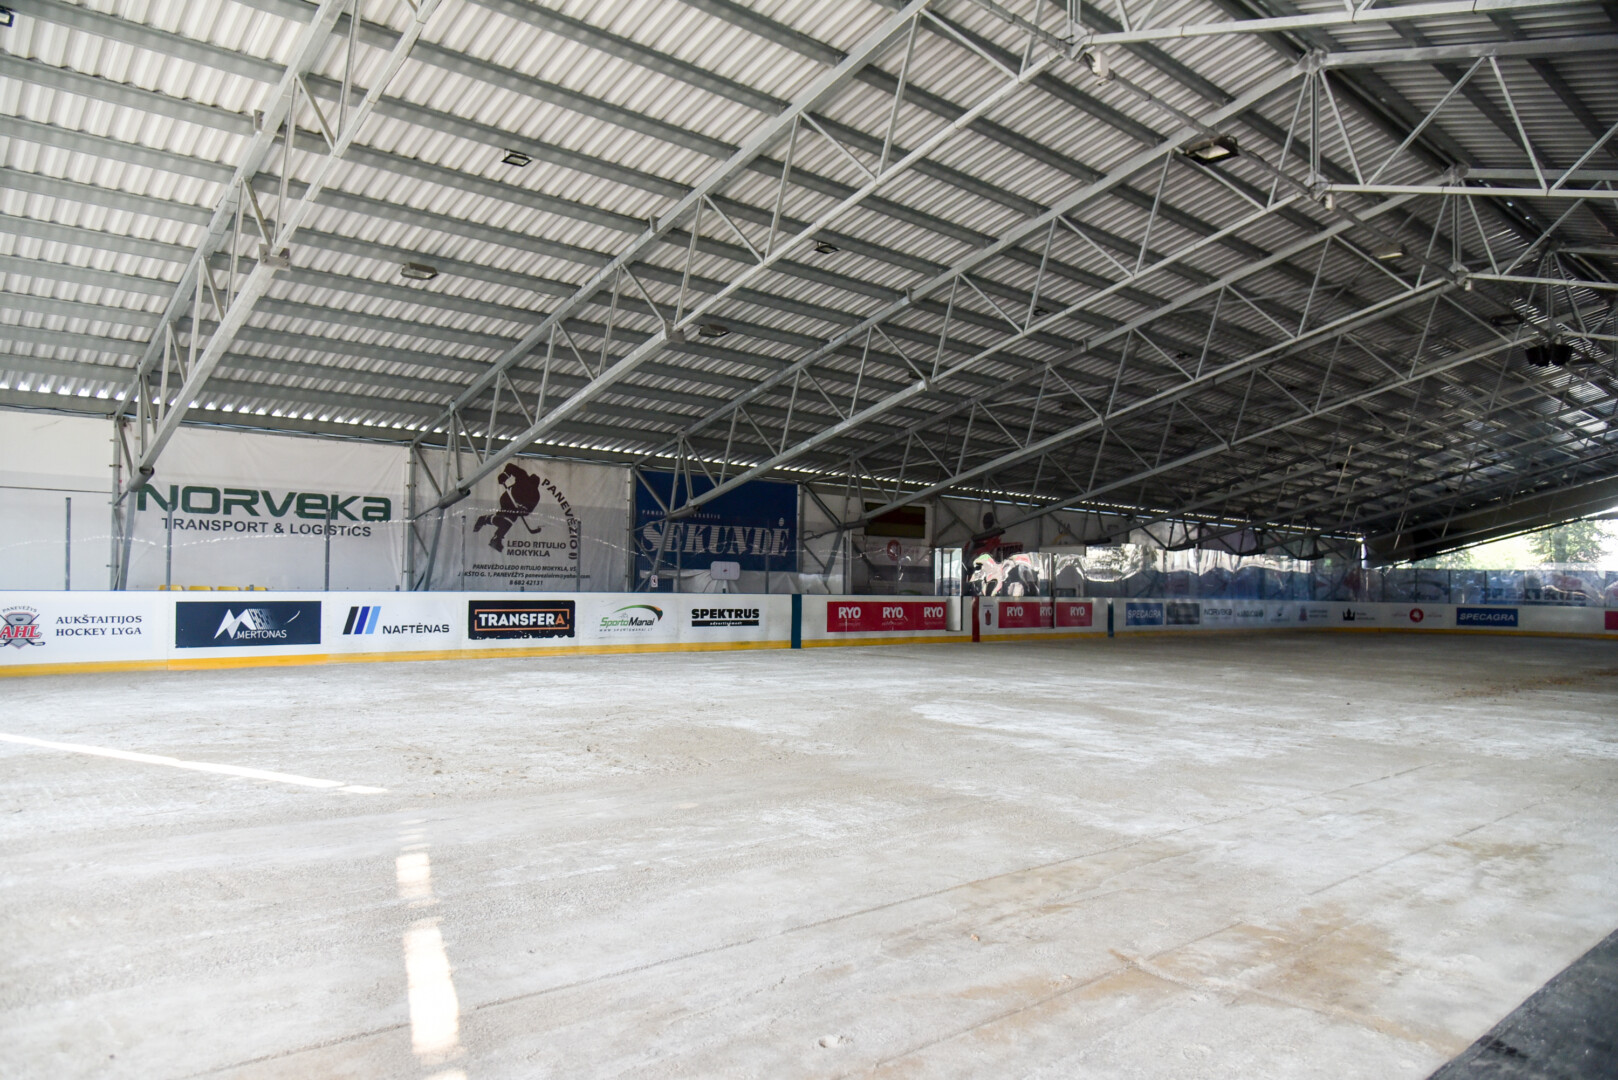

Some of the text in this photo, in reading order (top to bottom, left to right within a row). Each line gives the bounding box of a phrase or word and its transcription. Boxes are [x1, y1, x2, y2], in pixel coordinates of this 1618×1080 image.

[161, 517, 371, 537] TRANSPORT & LOGISTICS
[641, 517, 789, 557] SEKUNDĖ
[507, 540, 567, 549] LEDO RITULIO
[506, 549, 550, 557] MOKYKLA
[691, 608, 760, 619] SPEKTRUS
[838, 606, 861, 619] RYO
[882, 606, 904, 618] RYO
[923, 606, 944, 618] RYO
[1006, 606, 1024, 617] RYO
[1070, 606, 1086, 616] RYO
[1459, 612, 1515, 621] SPECAGRA
[55, 614, 142, 625] AUKŠTAITIJOS
[479, 613, 565, 626] TRANSFERA
[0, 624, 40, 638] AHL
[55, 627, 142, 637] HOCKEY LYGA
[382, 622, 450, 634] NAFTĖNAS
[237, 629, 287, 639] MERTONAS
